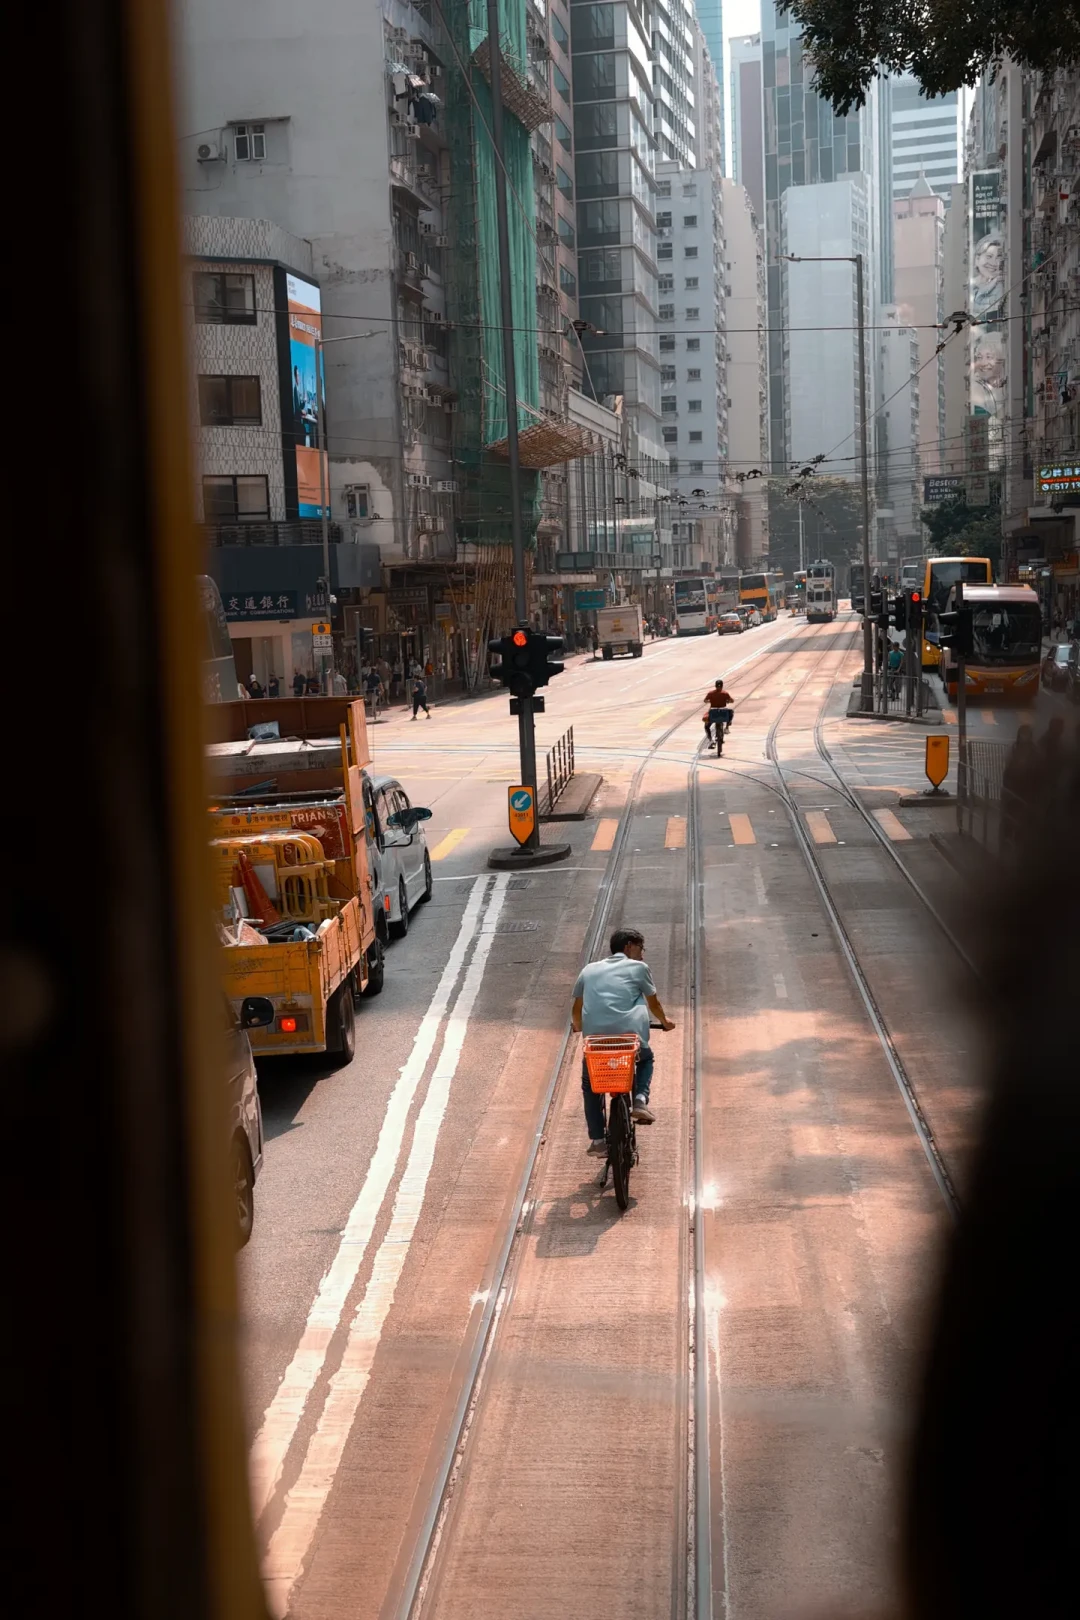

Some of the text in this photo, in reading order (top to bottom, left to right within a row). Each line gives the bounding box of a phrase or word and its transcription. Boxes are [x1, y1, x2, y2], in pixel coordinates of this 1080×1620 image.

[228, 595, 290, 610] 交通銀行
[249, 608, 295, 616] COMMUNICATIONS
